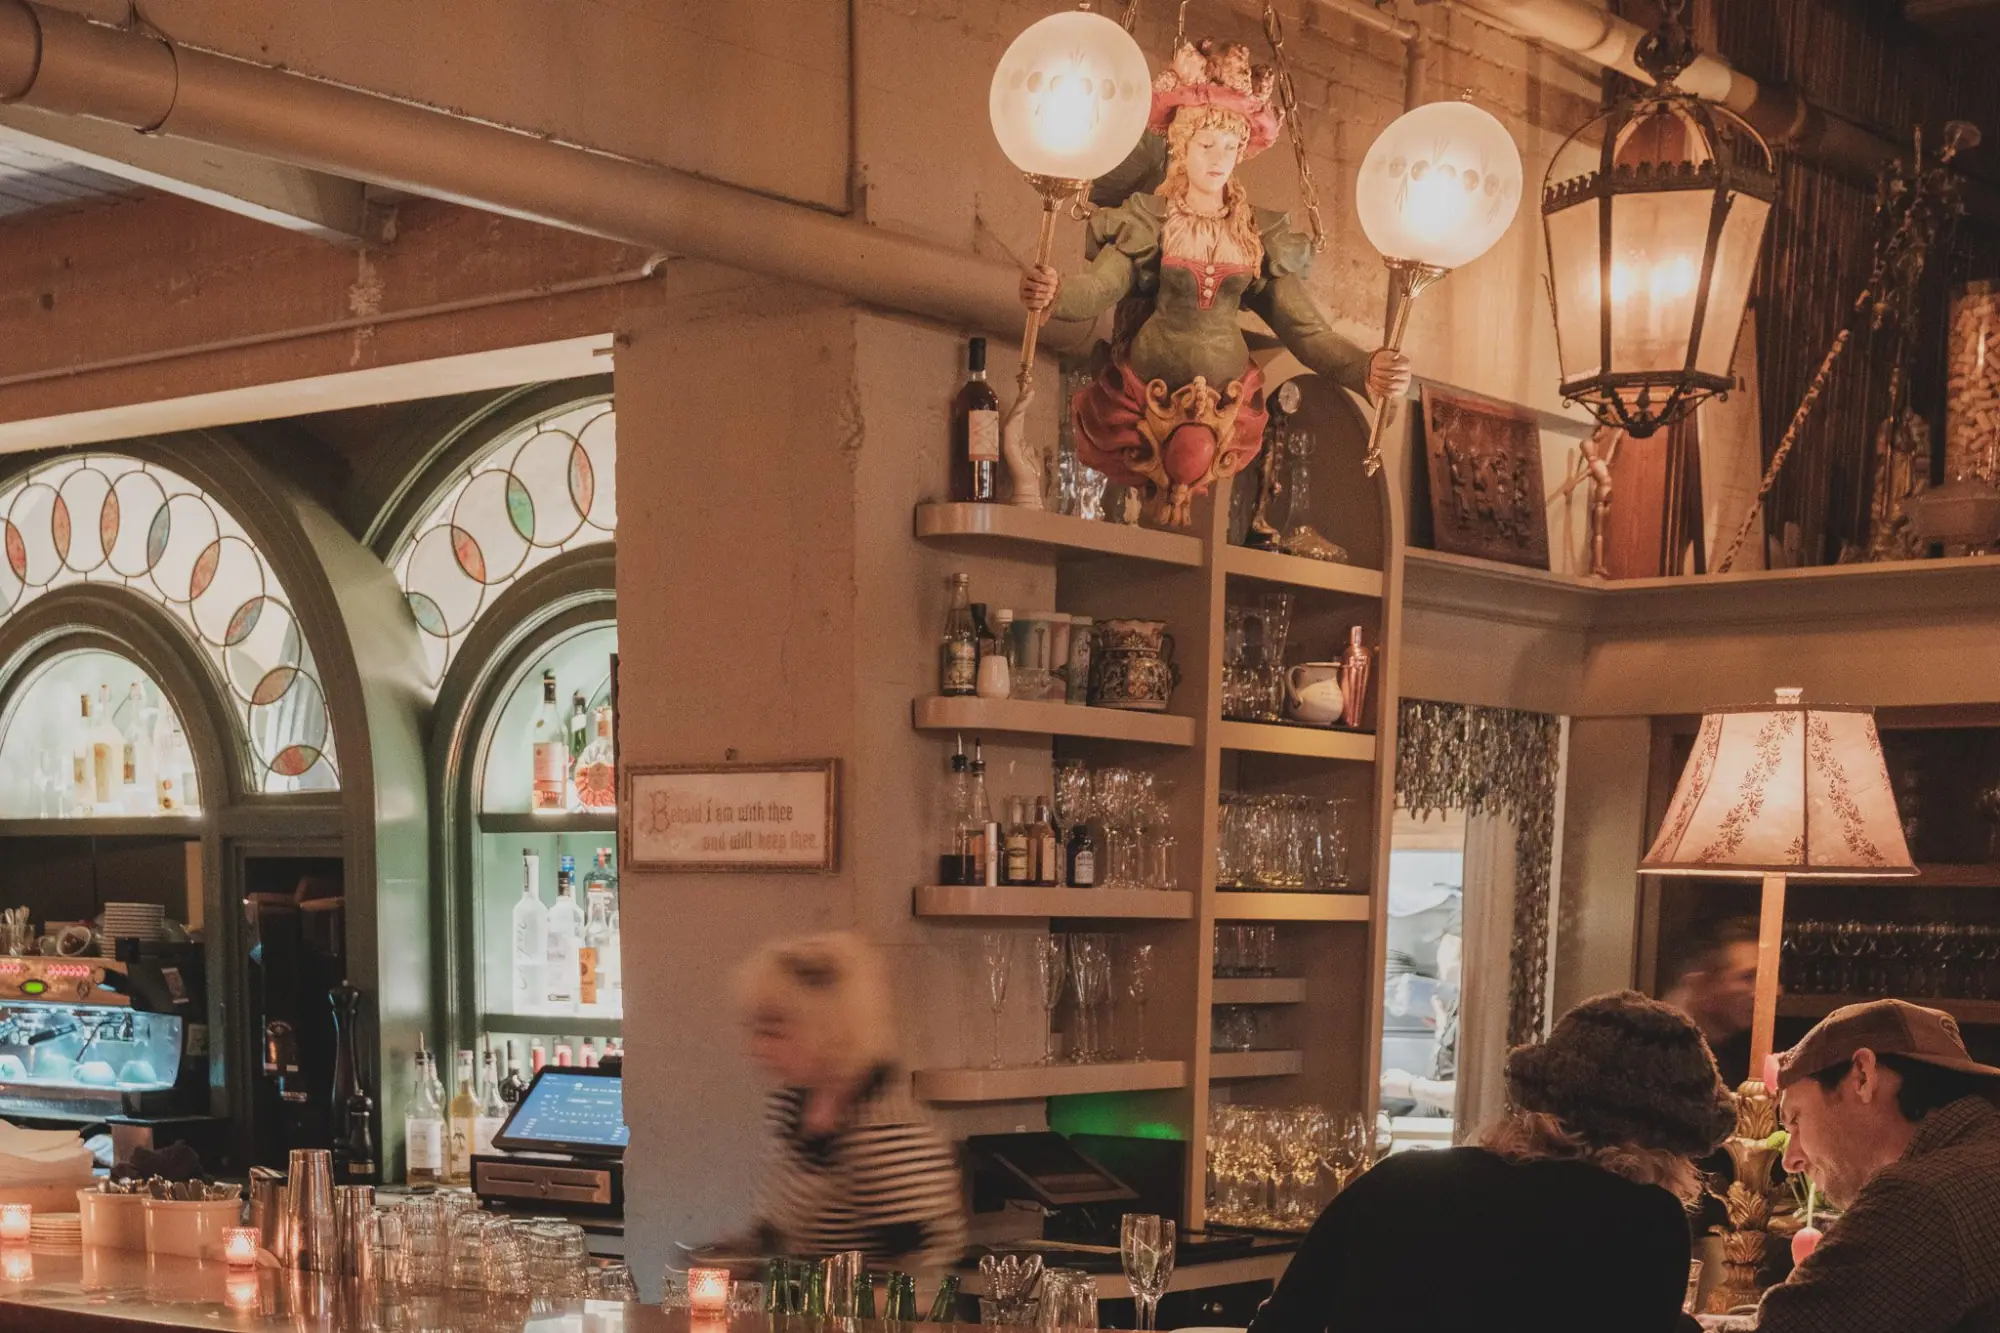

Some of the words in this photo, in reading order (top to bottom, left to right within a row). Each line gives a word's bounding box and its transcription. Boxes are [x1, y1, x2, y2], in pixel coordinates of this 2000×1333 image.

[648, 790, 702, 834] Behold
[716, 806, 735, 824] am
[738, 801, 764, 823] with
[768, 801, 794, 824] thee
[703, 831, 726, 852] and
[730, 829, 752, 850] will
[758, 831, 787, 854] keep
